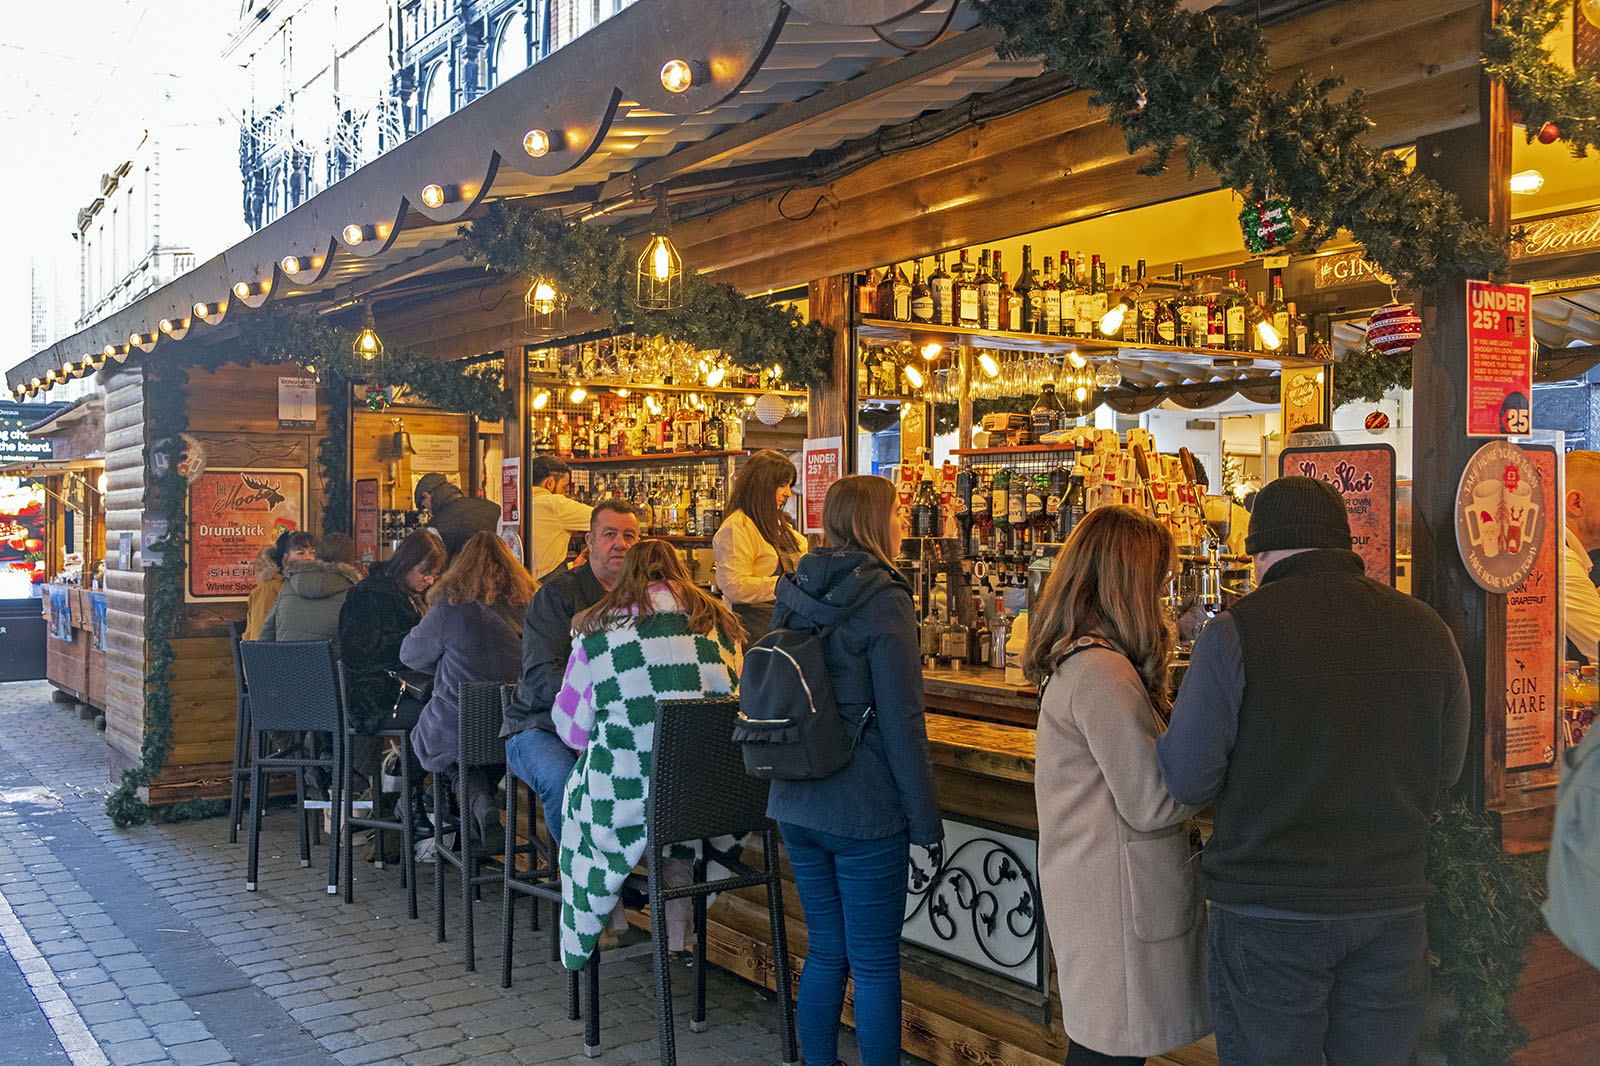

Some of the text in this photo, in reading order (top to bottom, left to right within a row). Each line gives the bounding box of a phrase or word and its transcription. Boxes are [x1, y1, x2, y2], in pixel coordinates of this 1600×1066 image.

[1333, 258, 1374, 278] GIN
[1472, 289, 1526, 313] UNDER
[1472, 309, 1501, 330] 25?
[1507, 408, 1529, 433] 25
[807, 453, 836, 464] UNDER
[807, 464, 822, 475] 25?
[1333, 461, 1374, 494] Shot
[1463, 465, 1480, 493] TAKE
[1477, 448, 1498, 471] HOME
[1498, 447, 1522, 462] YOURS
[1520, 458, 1539, 489] TODAY
[1345, 505, 1368, 513] RMER
[1352, 498, 1371, 507] OWN
[199, 524, 265, 537] Drumstick
[1468, 550, 1484, 576] TAKE
[1481, 570, 1500, 588] HOME
[1500, 571, 1522, 588] YOURS
[1520, 546, 1537, 574] TODAY
[206, 582, 233, 591] Winter
[1510, 595, 1547, 606] GRAPEFRUIT
[1510, 677, 1537, 695] GIN
[1505, 694, 1546, 715] MARE
